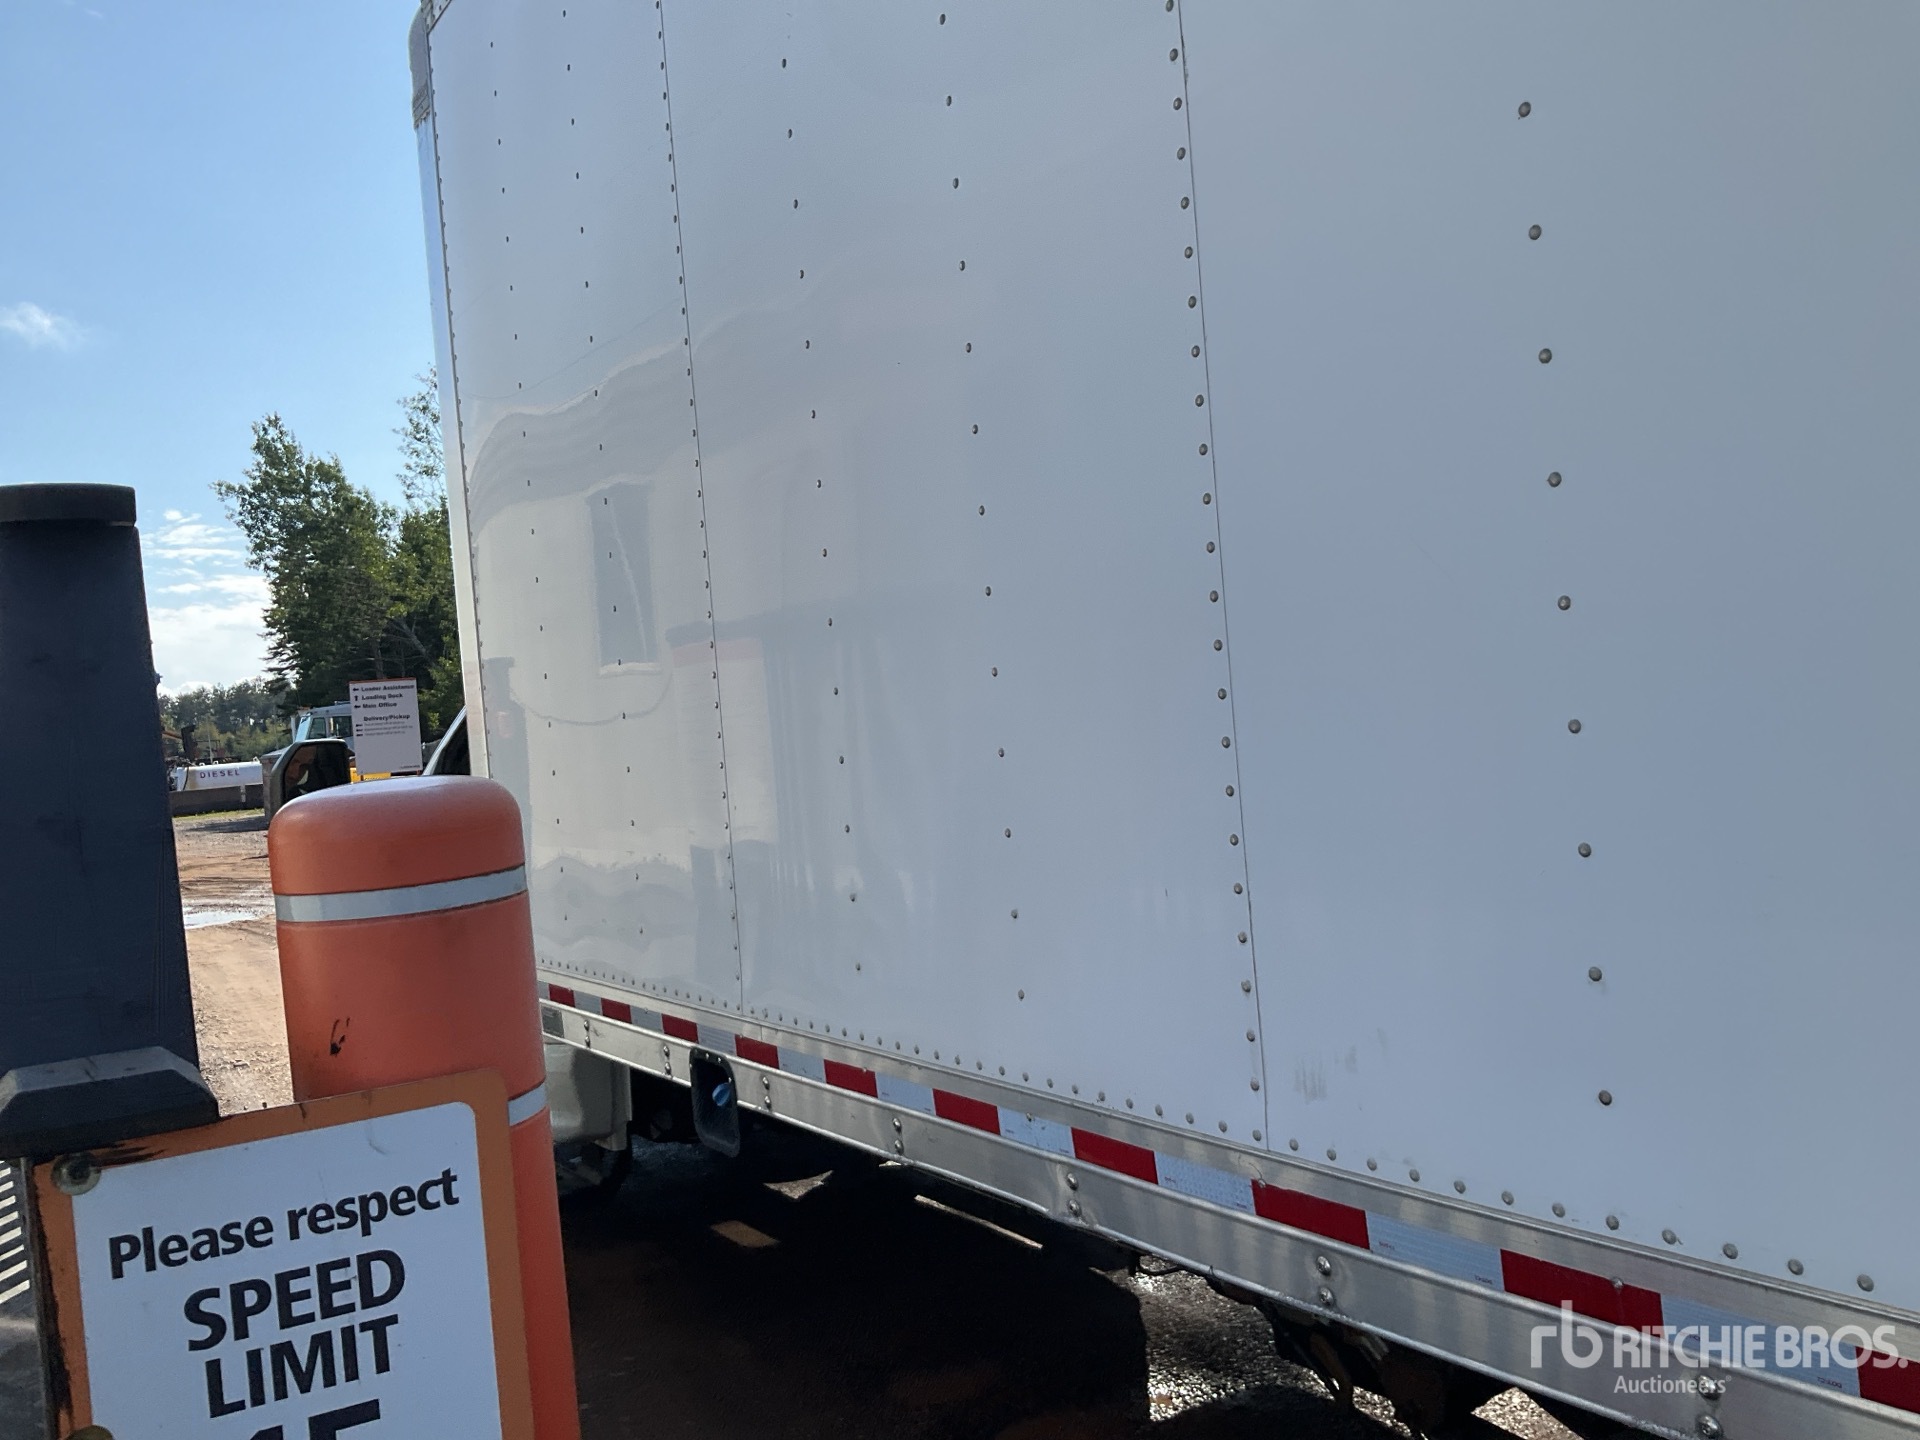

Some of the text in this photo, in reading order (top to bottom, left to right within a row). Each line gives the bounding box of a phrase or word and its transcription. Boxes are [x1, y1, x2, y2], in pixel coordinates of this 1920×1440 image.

[200, 769, 240, 779] DIESEL
[108, 1167, 460, 1280] Please respect
[183, 1248, 406, 1352] SPEED
[205, 1313, 400, 1419] LIMIT
